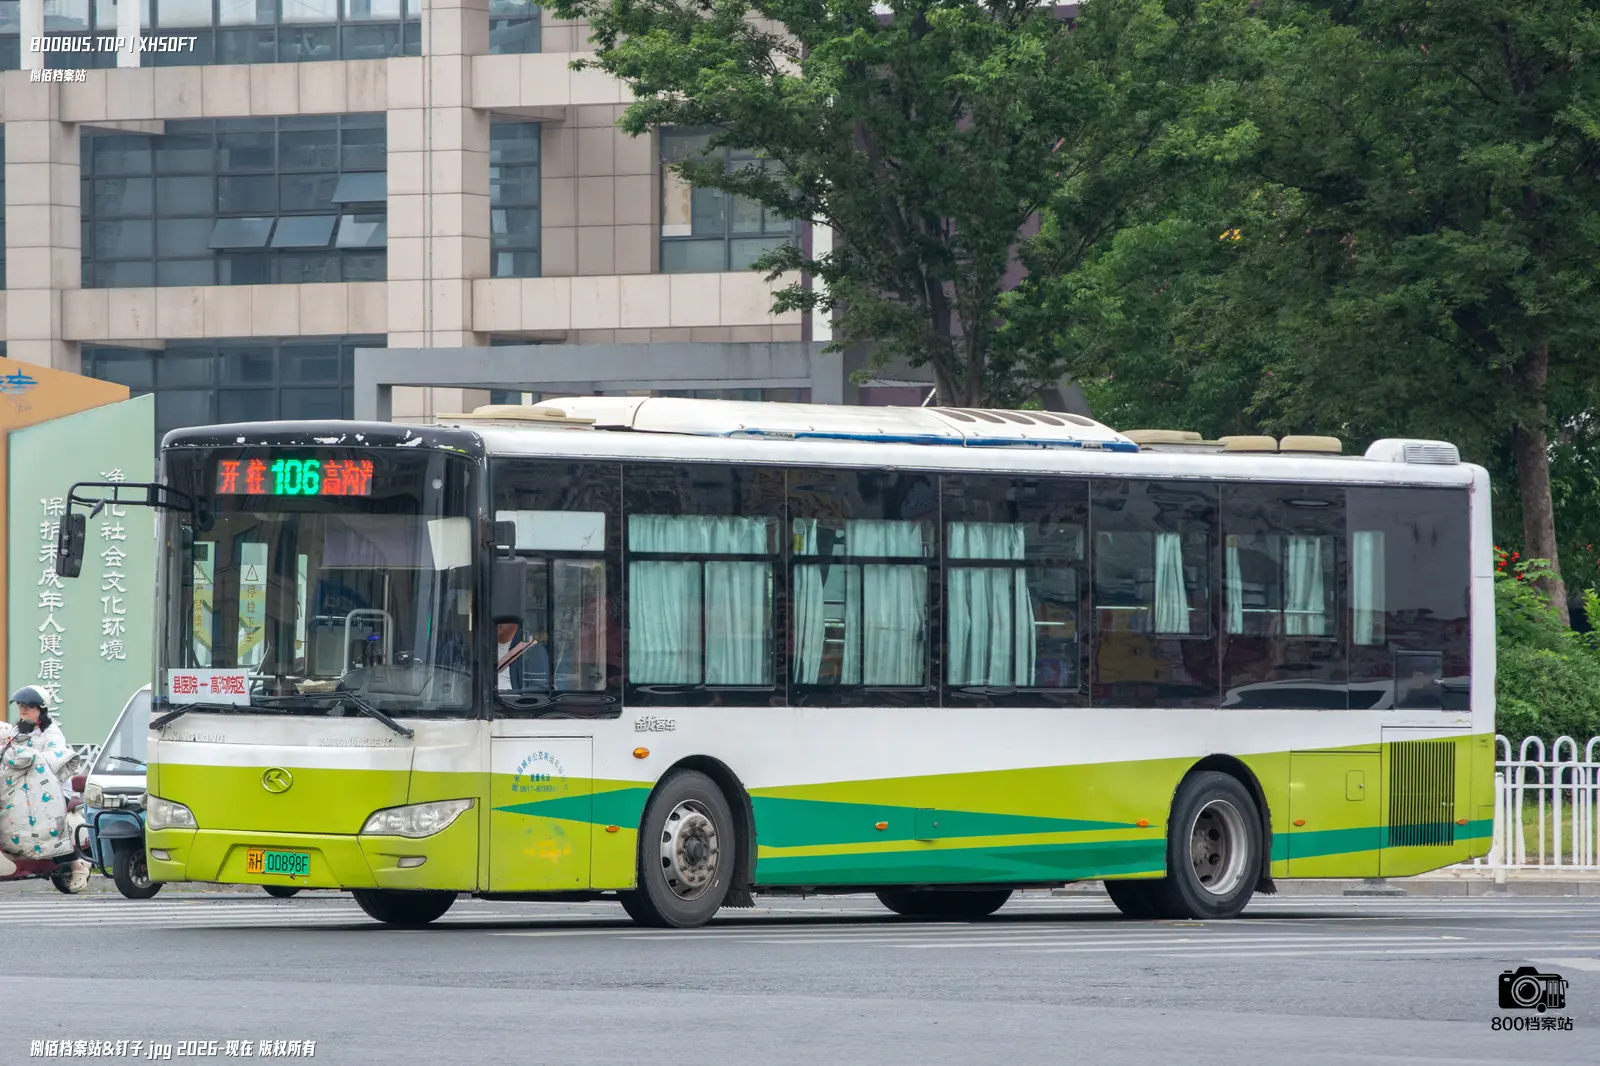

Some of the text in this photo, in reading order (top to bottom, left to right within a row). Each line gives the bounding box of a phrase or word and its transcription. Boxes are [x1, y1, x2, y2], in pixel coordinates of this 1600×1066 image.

[271, 458, 321, 496] 106
[173, 675, 246, 695] 县医院 高沟院区
